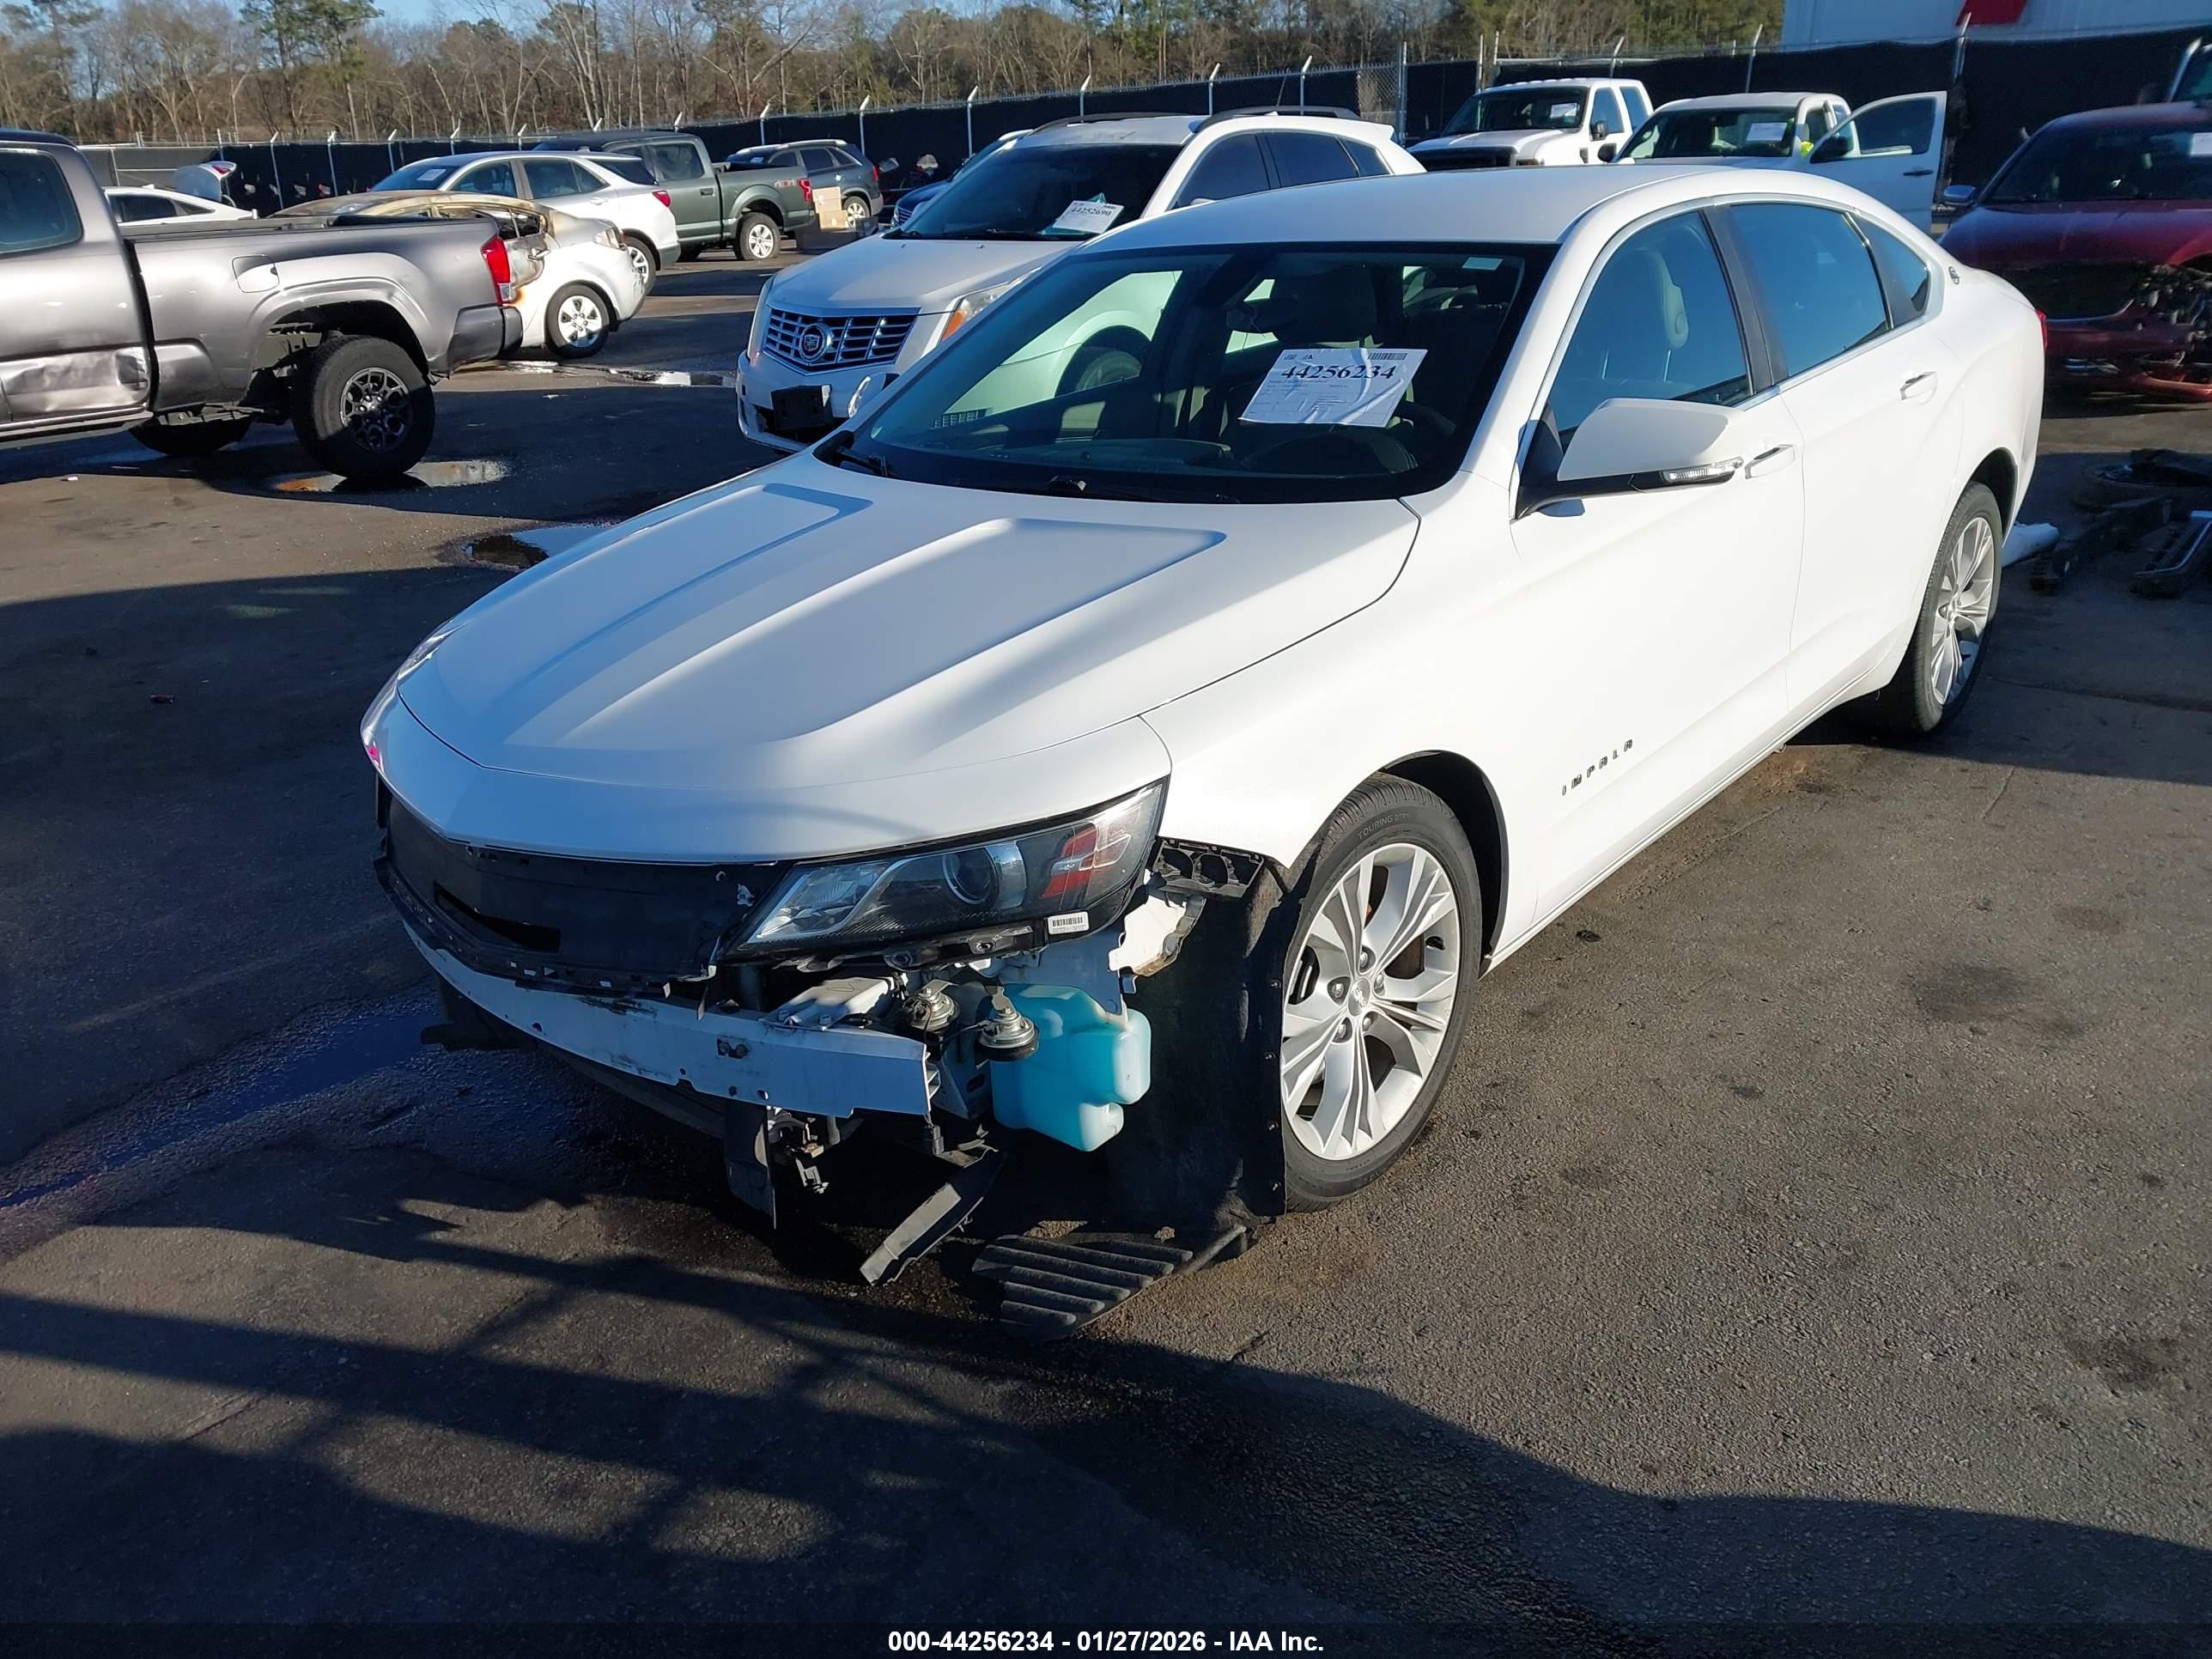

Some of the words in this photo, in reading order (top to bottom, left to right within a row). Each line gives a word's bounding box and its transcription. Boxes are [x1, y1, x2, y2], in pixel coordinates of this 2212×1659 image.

[1281, 365, 1396, 379] 44256234
[1562, 738, 1633, 796] IMPALA
[1357, 814, 1393, 839] TOURING
